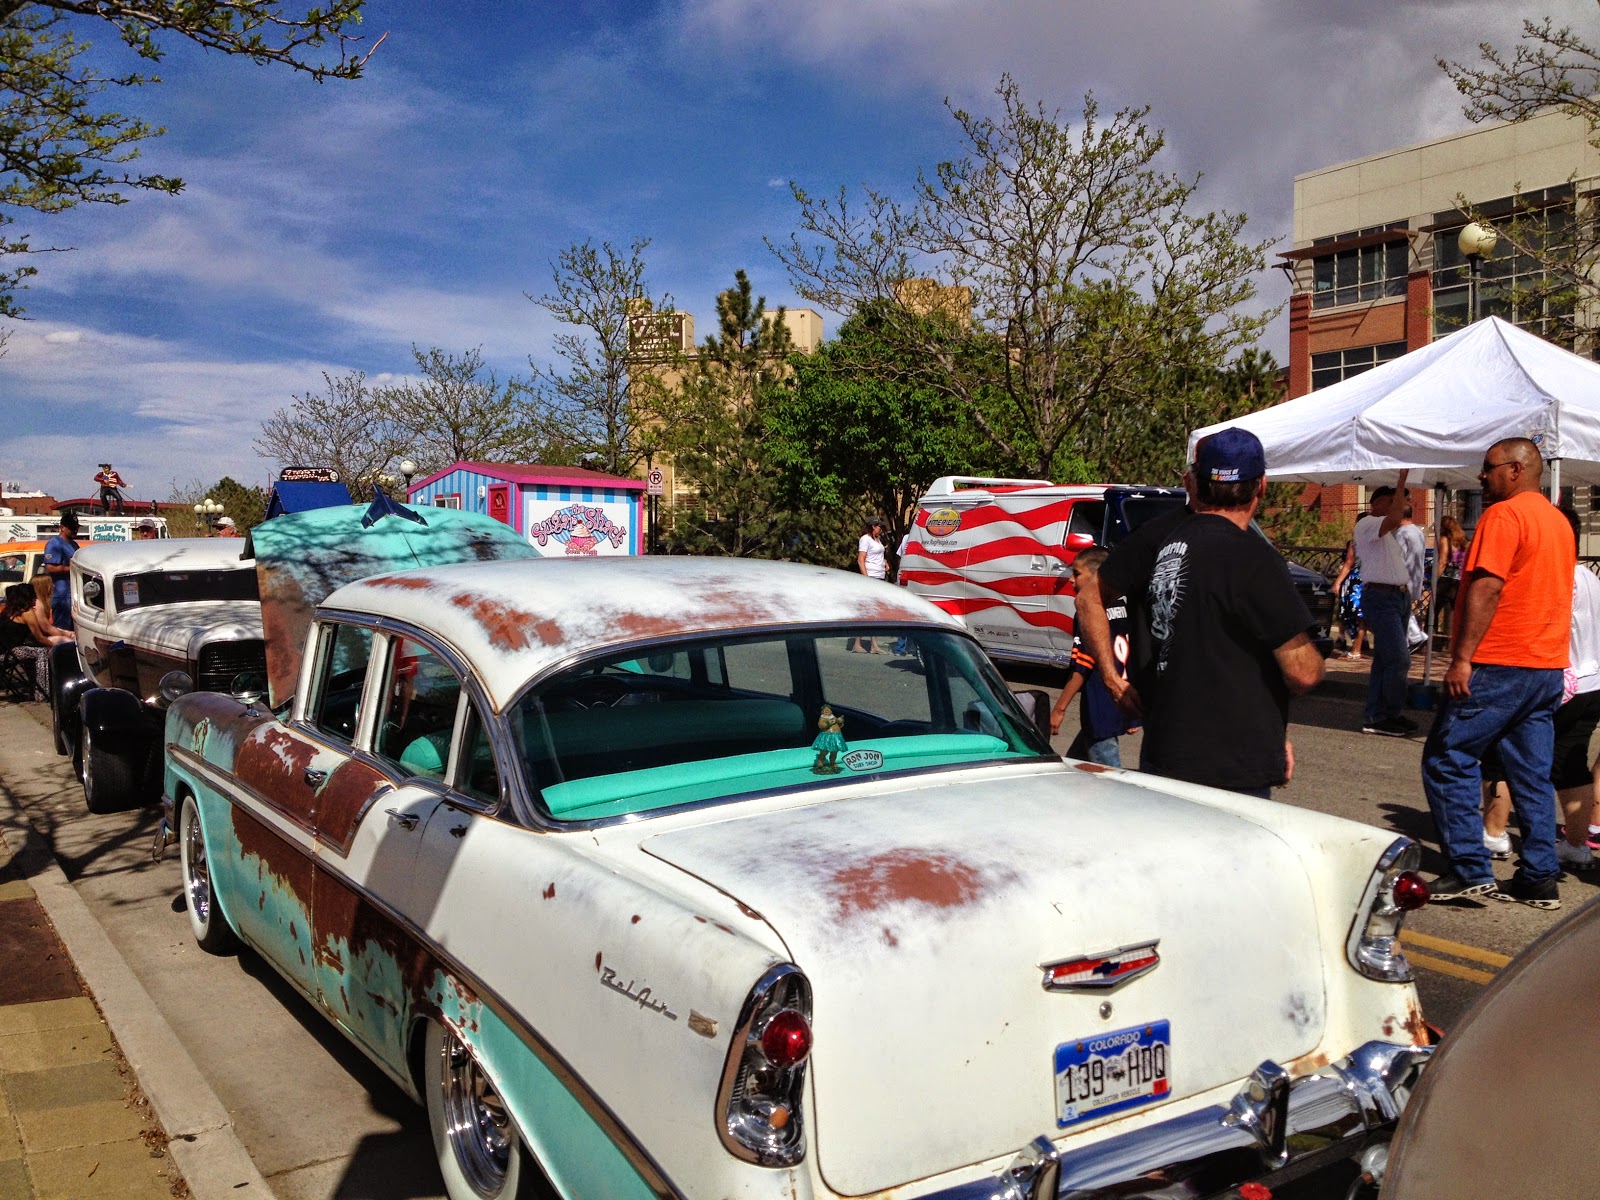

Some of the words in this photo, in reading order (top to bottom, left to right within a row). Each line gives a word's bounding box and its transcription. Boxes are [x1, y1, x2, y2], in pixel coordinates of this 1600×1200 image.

[584, 508, 627, 549] Shack
[926, 519, 961, 527] AMERICAN
[846, 752, 862, 766] RON
[864, 752, 880, 761] JON
[1088, 1031, 1141, 1052] COLORADO
[1064, 1059, 1104, 1105] 139
[1127, 1043, 1166, 1087] HDQ
[1092, 1093, 1120, 1107] COLLECTOR
[1120, 1088, 1141, 1099] VEHICLE
[1067, 1106, 1073, 1116] 2
